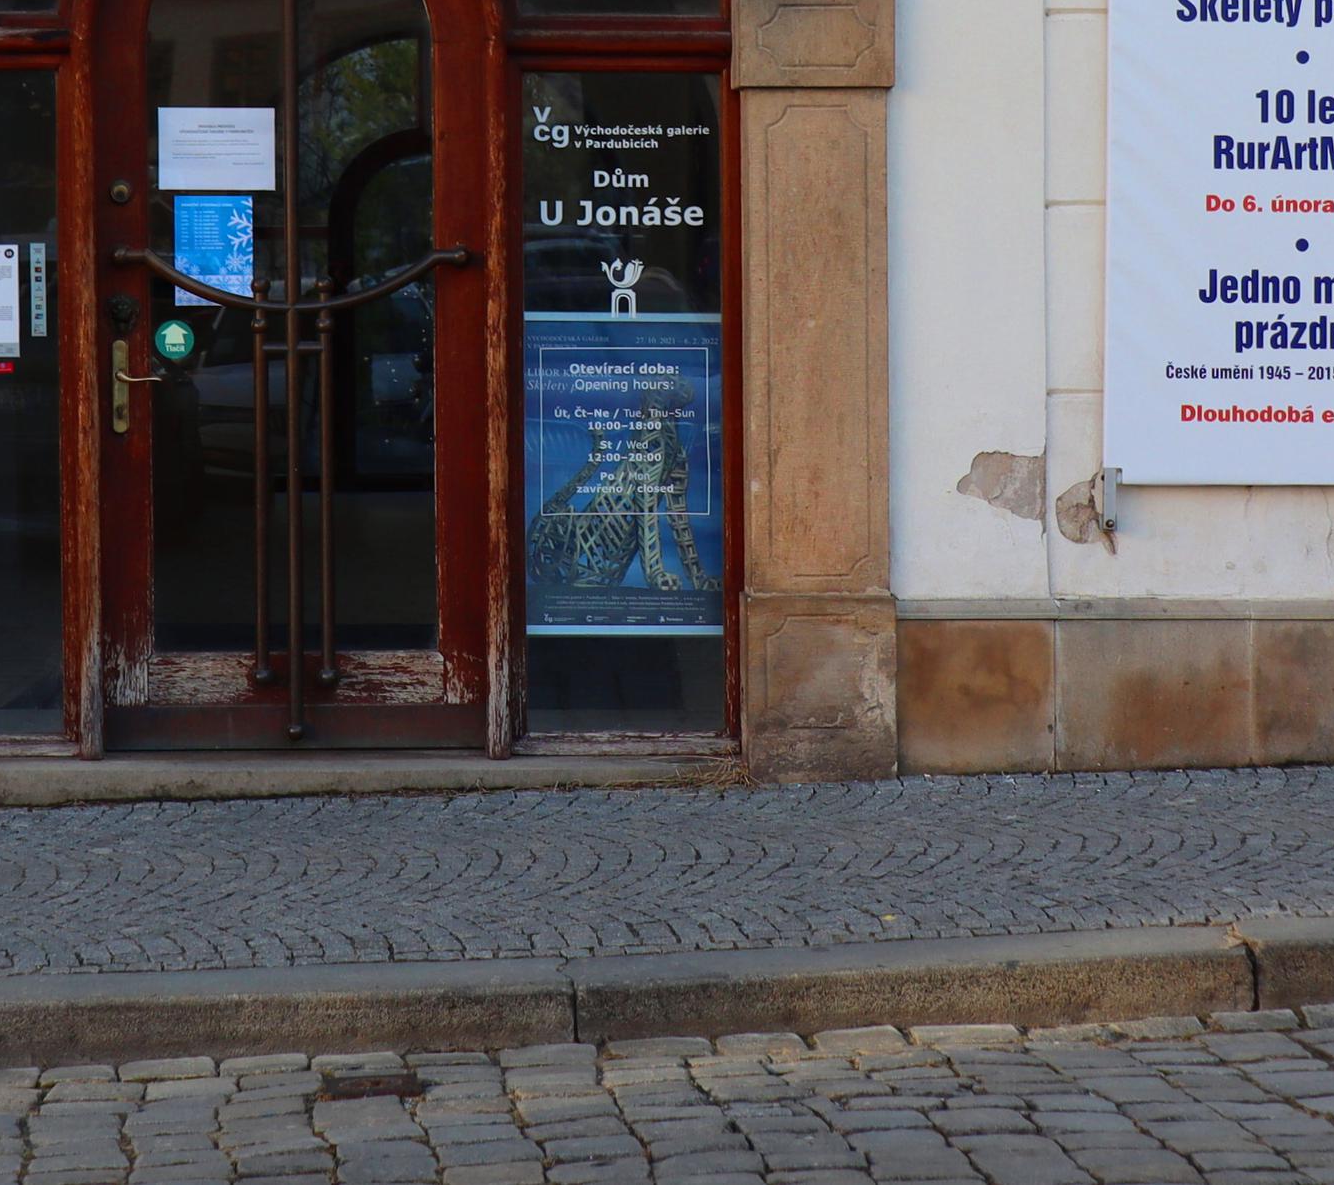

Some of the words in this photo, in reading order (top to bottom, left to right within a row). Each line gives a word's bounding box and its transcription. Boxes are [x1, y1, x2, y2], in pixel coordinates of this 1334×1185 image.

[1255, 89, 1295, 124] 10
[574, 125, 663, 137] Východočeská
[667, 126, 710, 137] galerie
[575, 141, 582, 149] v
[586, 138, 659, 149] Pardubicích
[594, 168, 649, 188] Dům
[1206, 195, 1235, 212] Do
[1243, 195, 1262, 213] 6.
[1271, 195, 1334, 213] února
[540, 200, 563, 226] U
[577, 197, 704, 226] Jonáše
[1199, 269, 1301, 304] Jedno
[570, 363, 634, 375] Otevírací
[639, 363, 679, 375] doba:
[1166, 361, 1207, 379] České
[1212, 363, 1253, 379] umění
[1259, 366, 1291, 380] 1945
[575, 379, 628, 392] Opening
[634, 379, 674, 390] hours:
[555, 406, 571, 418] Út,
[623, 409, 645, 419] Tue,
[1181, 405, 1315, 423] Dlouhodobá
[599, 440, 613, 450] St
[626, 440, 648, 450] Wed
[600, 472, 614, 481] Po
[629, 472, 649, 481] Mon
[576, 483, 624, 494] zavřeno
[637, 484, 674, 494] closed
